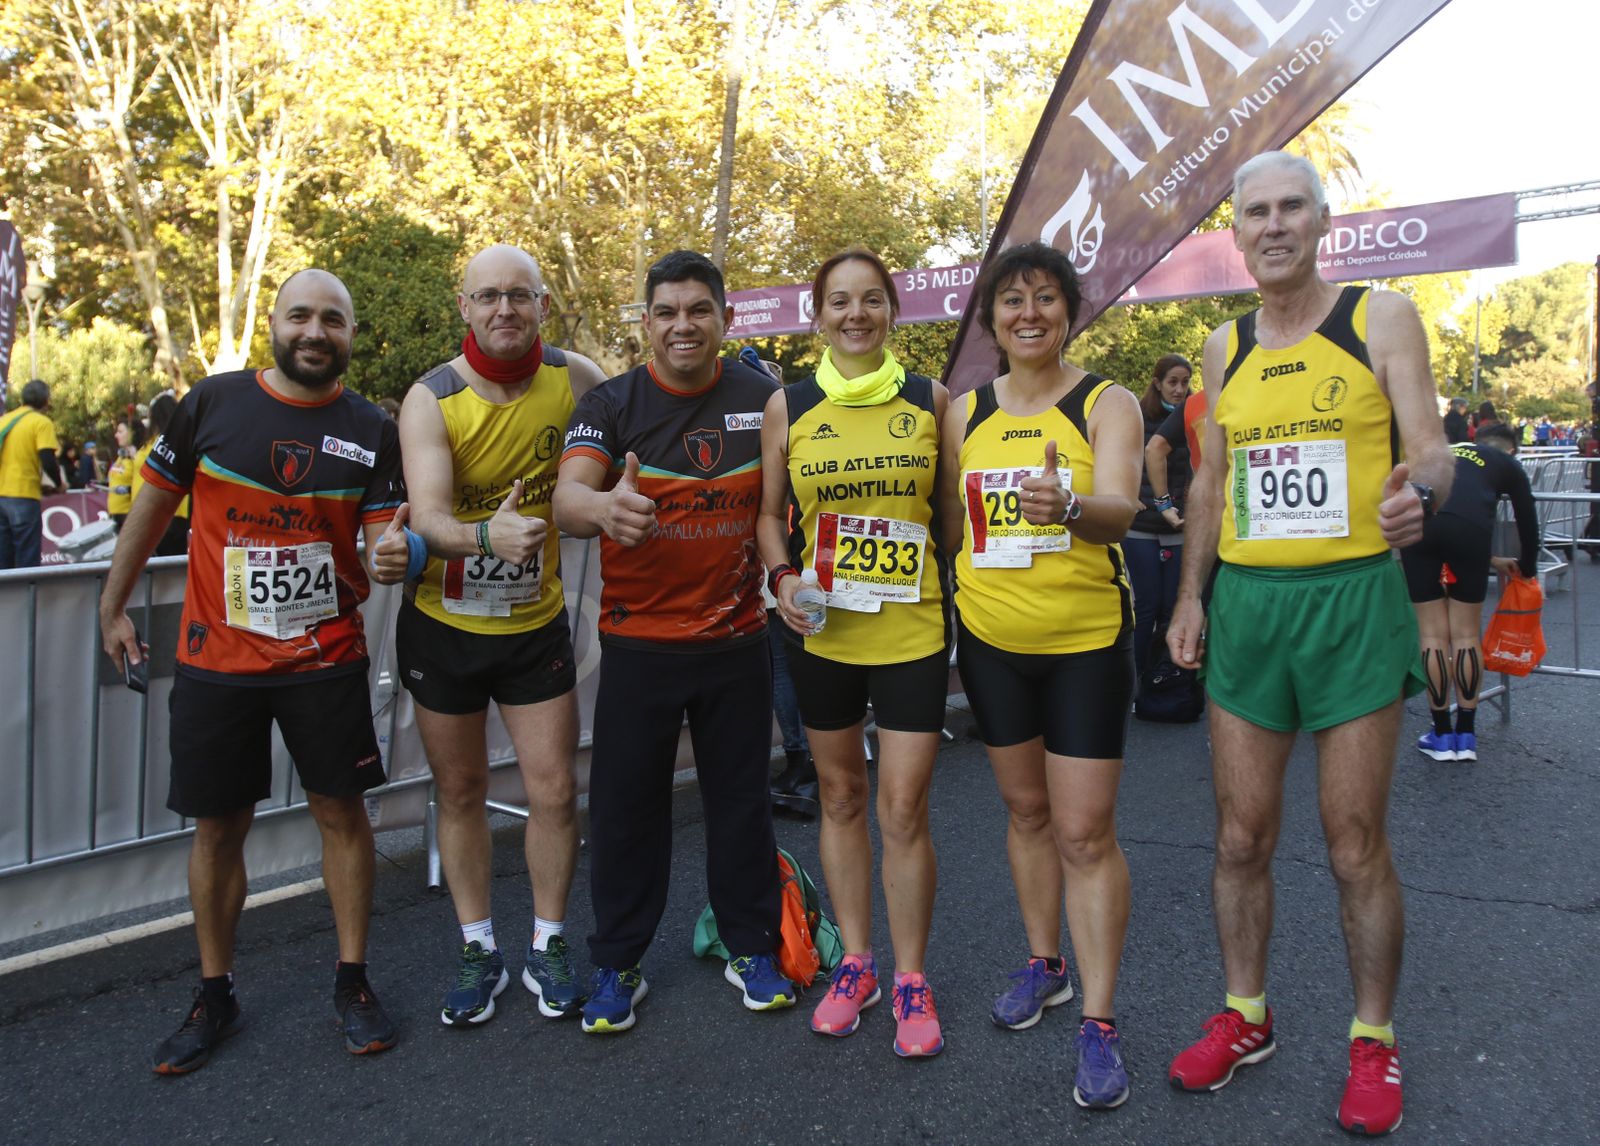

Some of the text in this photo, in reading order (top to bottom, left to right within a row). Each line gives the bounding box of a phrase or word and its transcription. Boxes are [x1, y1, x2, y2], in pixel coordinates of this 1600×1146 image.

[1139, 126, 1231, 210] Instituto
[1228, 17, 1345, 128] Municipal
[1334, 258, 1345, 267] de
[1347, 254, 1386, 265] Deportes
[1388, 249, 1428, 260] Córdoba
[905, 273, 928, 292] 35
[932, 266, 980, 288] MEDI
[1234, 418, 1343, 444] CLUB ATLETISMO
[338, 443, 374, 466] Inditer
[800, 455, 930, 477] CLUB ATLETISMO
[817, 480, 917, 502] MONTILLA
[1260, 467, 1328, 509] 960
[985, 490, 1022, 527] 29
[1264, 511, 1312, 520] RODRIGUEZ
[1314, 510, 1344, 519] LOPEZ
[652, 520, 704, 540] BATALLA
[1036, 527, 1066, 537] GARCIA
[837, 536, 919, 576] 2933
[232, 564, 244, 610] CAJÓN 5
[249, 562, 333, 605] 5524
[833, 572, 917, 586] ANA HERRADOR LUQUE
[275, 603, 305, 613] MONTES
[306, 596, 335, 608] JIMENEZ
